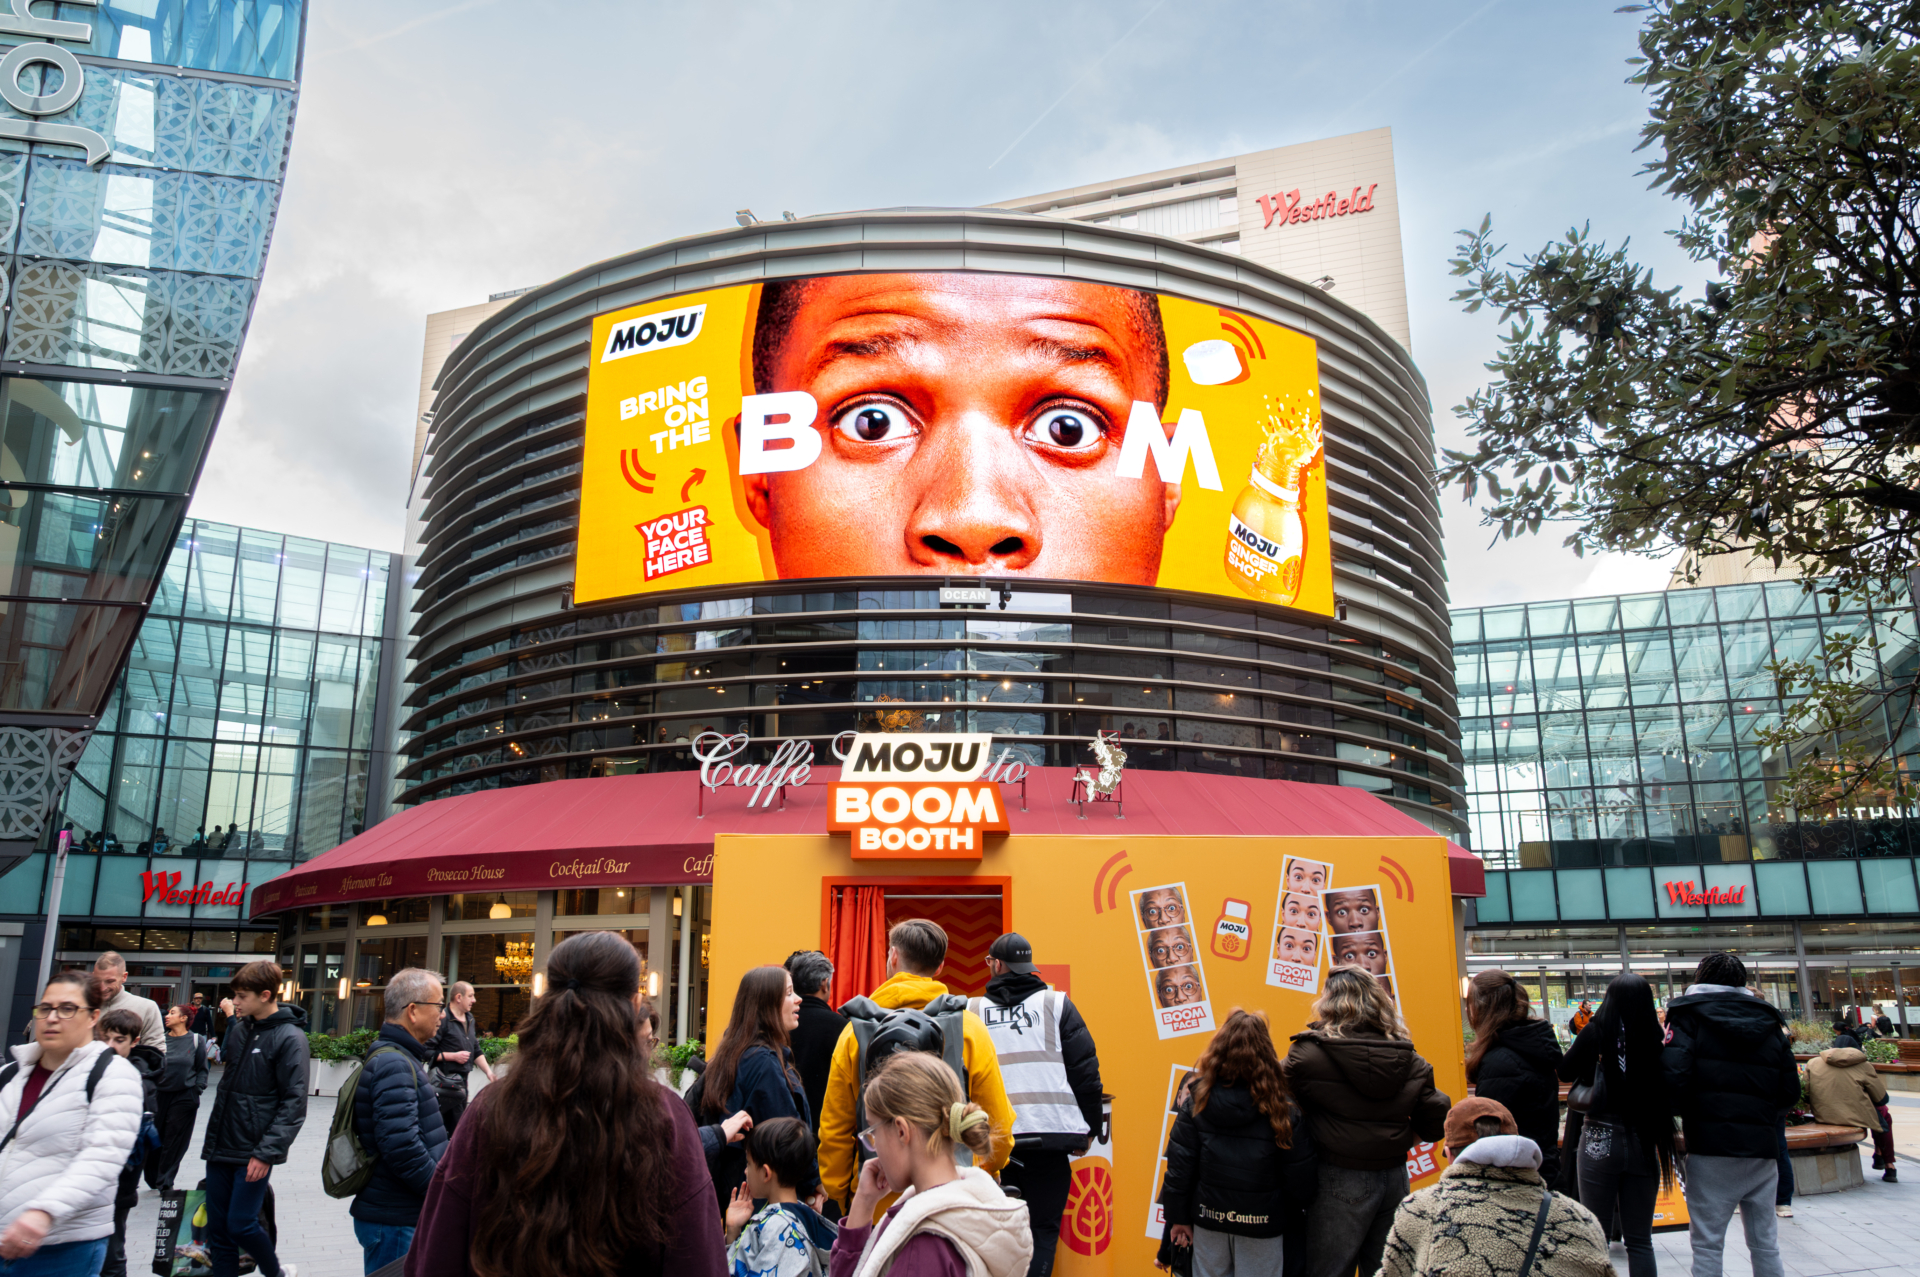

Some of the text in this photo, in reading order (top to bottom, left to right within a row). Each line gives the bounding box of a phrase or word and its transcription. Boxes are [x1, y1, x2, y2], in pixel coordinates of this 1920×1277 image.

[1255, 183, 1378, 229] Westfield
[620, 376, 708, 421] BRING
[664, 398, 708, 427] ON
[650, 420, 710, 454] THE
[641, 508, 706, 541] YOUR
[647, 527, 704, 559] FACE
[1234, 523, 1279, 557] MOJU
[646, 544, 709, 577] HERE
[1228, 551, 1264, 582] SHOT
[1230, 539, 1278, 576] GINGER
[944, 590, 986, 600] OCEAN
[853, 742, 982, 772] MOJU
[835, 786, 1000, 823] BOOM
[859, 827, 974, 851] BOOTH
[427, 865, 505, 881] Prosecco House
[549, 857, 631, 879] Cocktail Bar
[139, 870, 251, 906] Westfield
[338, 872, 393, 895] Afternoon Tea
[1663, 880, 1747, 906] Westfield
[1219, 922, 1246, 934] MOJU
[1274, 964, 1312, 980] BOOM
[1281, 976, 1303, 986] FACE
[986, 1005, 1023, 1024] LTK
[1162, 1007, 1206, 1024] BOOM
[1173, 1020, 1199, 1031] FACE
[160, 1210, 177, 1218] FROM
[171, 1200, 178, 1208] IS
[1199, 1203, 1269, 1224] Juicy Couture
